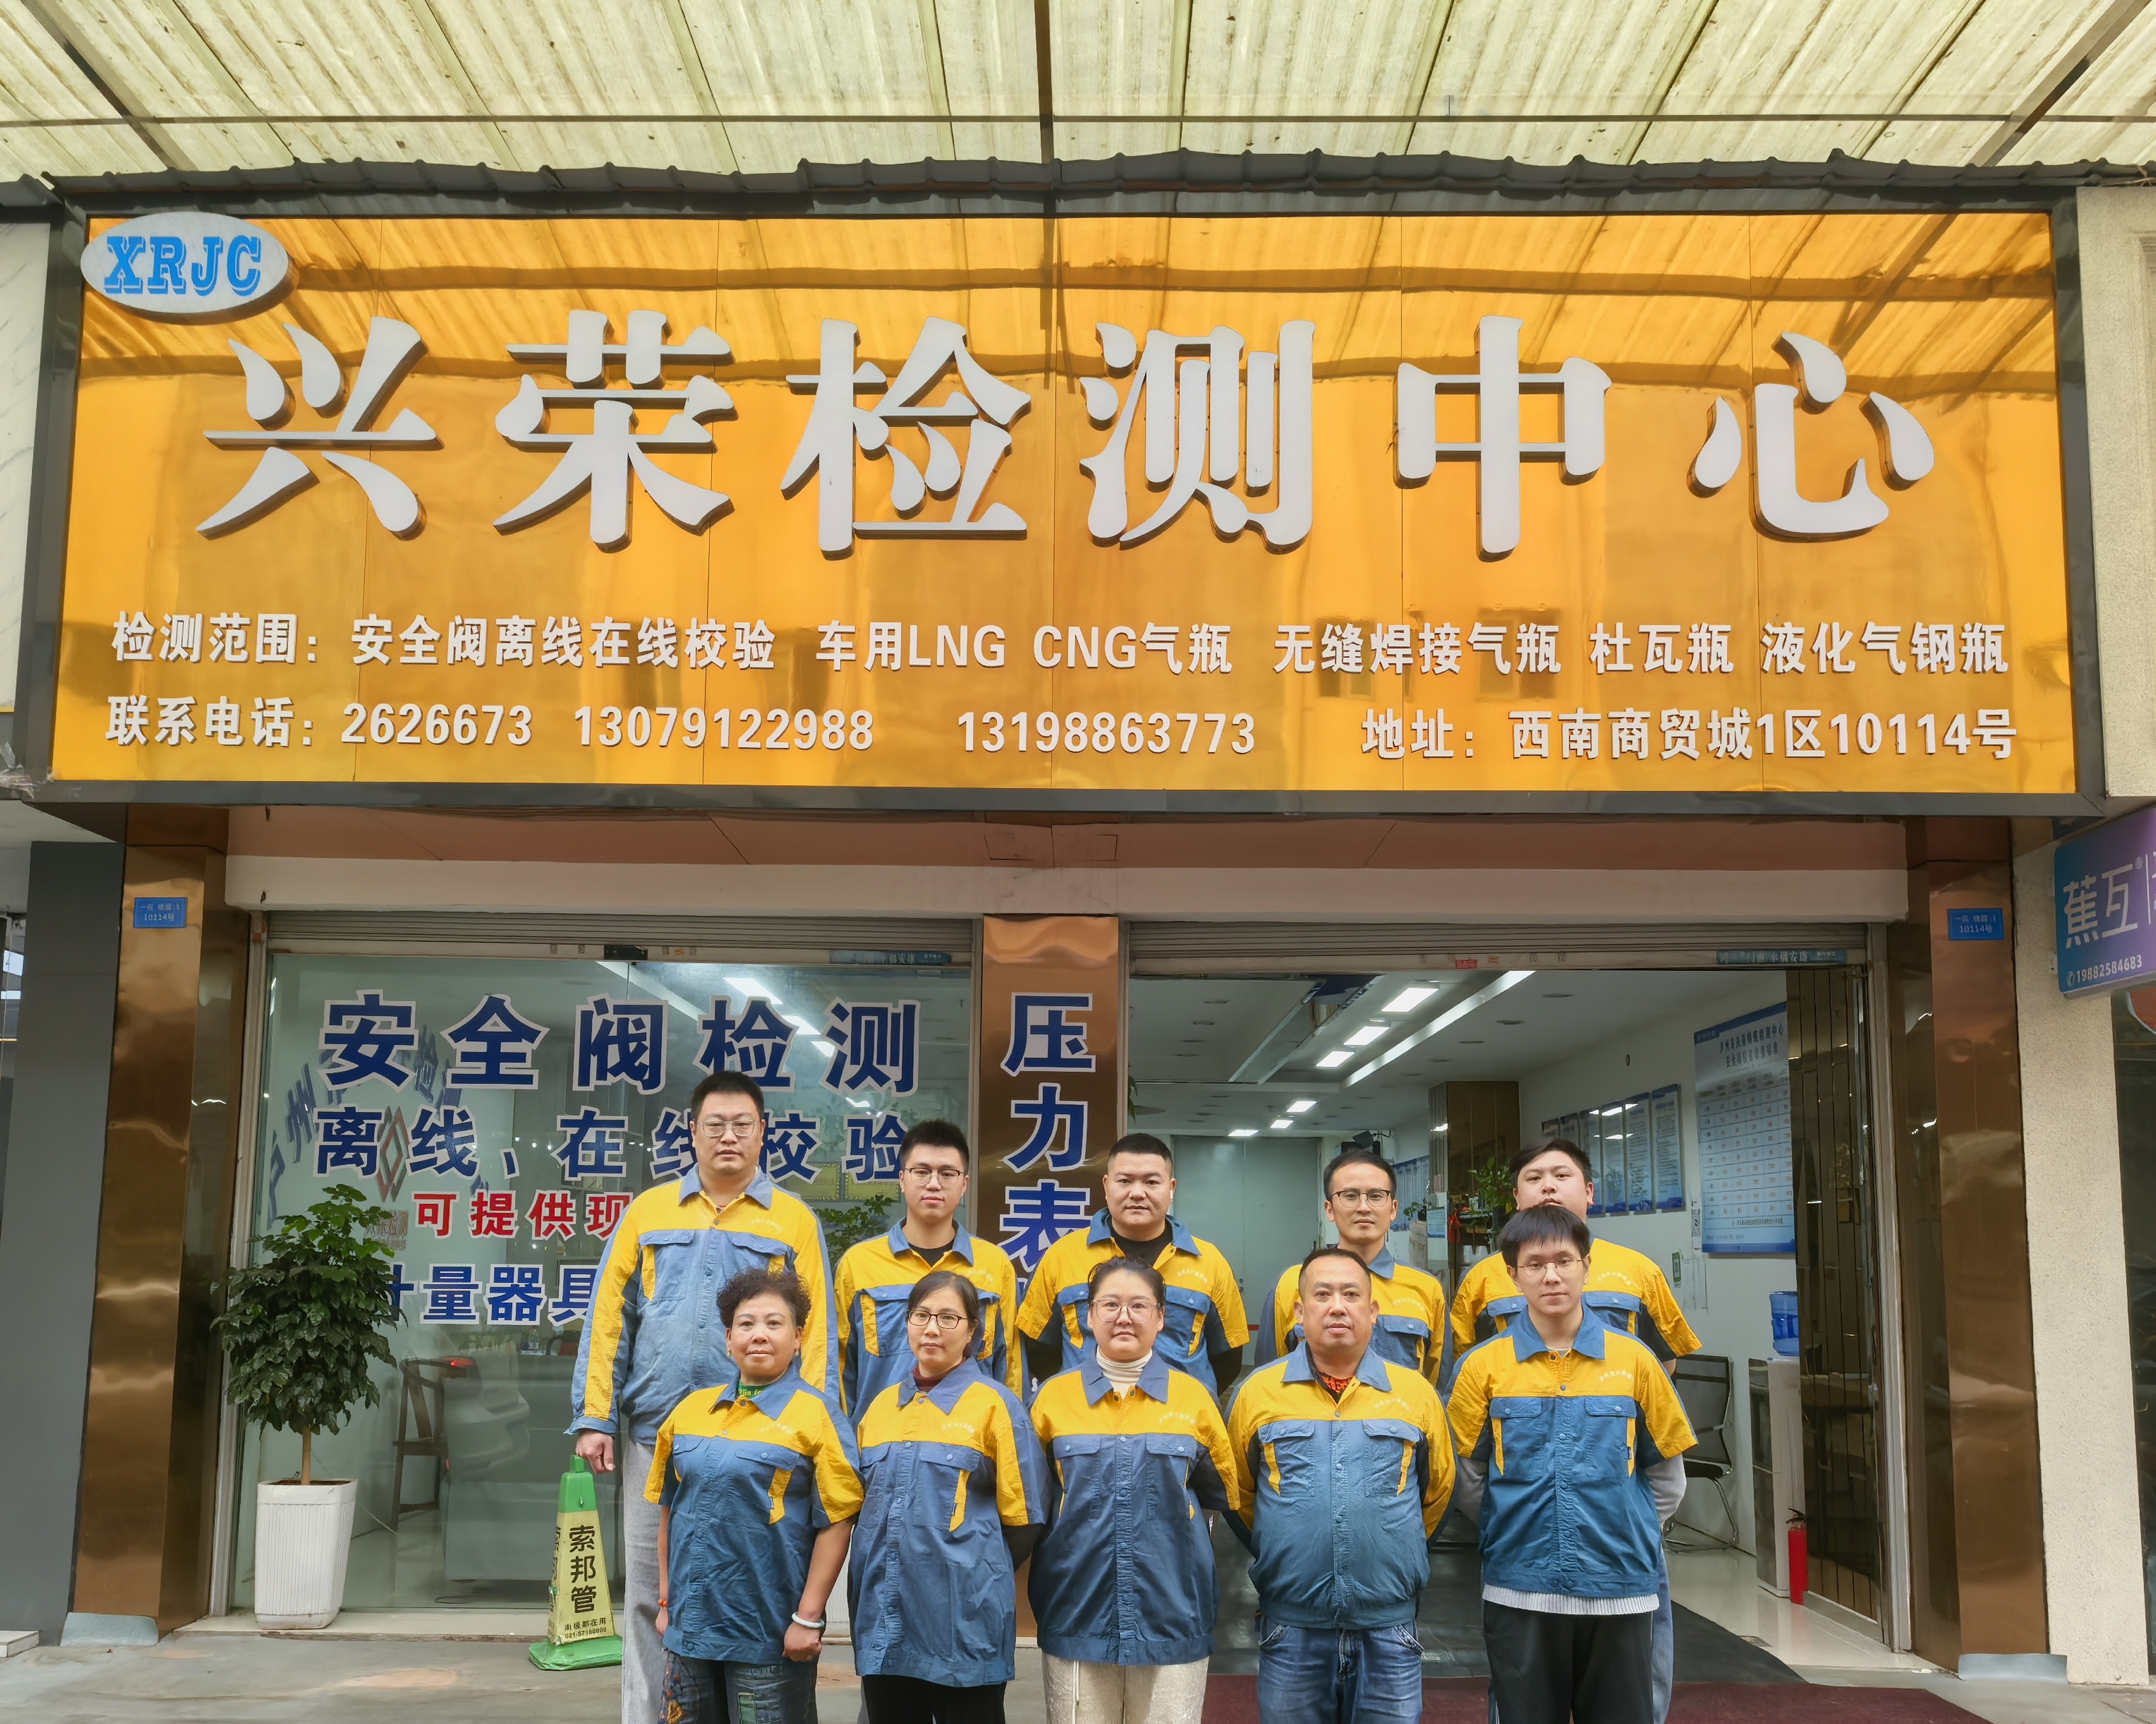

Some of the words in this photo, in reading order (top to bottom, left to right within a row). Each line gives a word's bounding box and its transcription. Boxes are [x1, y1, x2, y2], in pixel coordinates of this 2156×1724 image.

[103, 235, 263, 297] XRJC
[195, 309, 1938, 563] 兴荣检测中心
[816, 619, 1006, 672] 车用LNG
[1033, 621, 1233, 674] CNG气瓶
[1274, 621, 1562, 674] 无缝焊接气瓶
[1588, 621, 1734, 674] 杜瓦瓶
[1761, 621, 2009, 674] 液化气钢瓶
[574, 704, 874, 751] 13079122988
[957, 710, 1256, 755] 13198863773
[321, 990, 920, 1094] 安全阀检测
[569, 1526, 596, 1613] 索邦管
